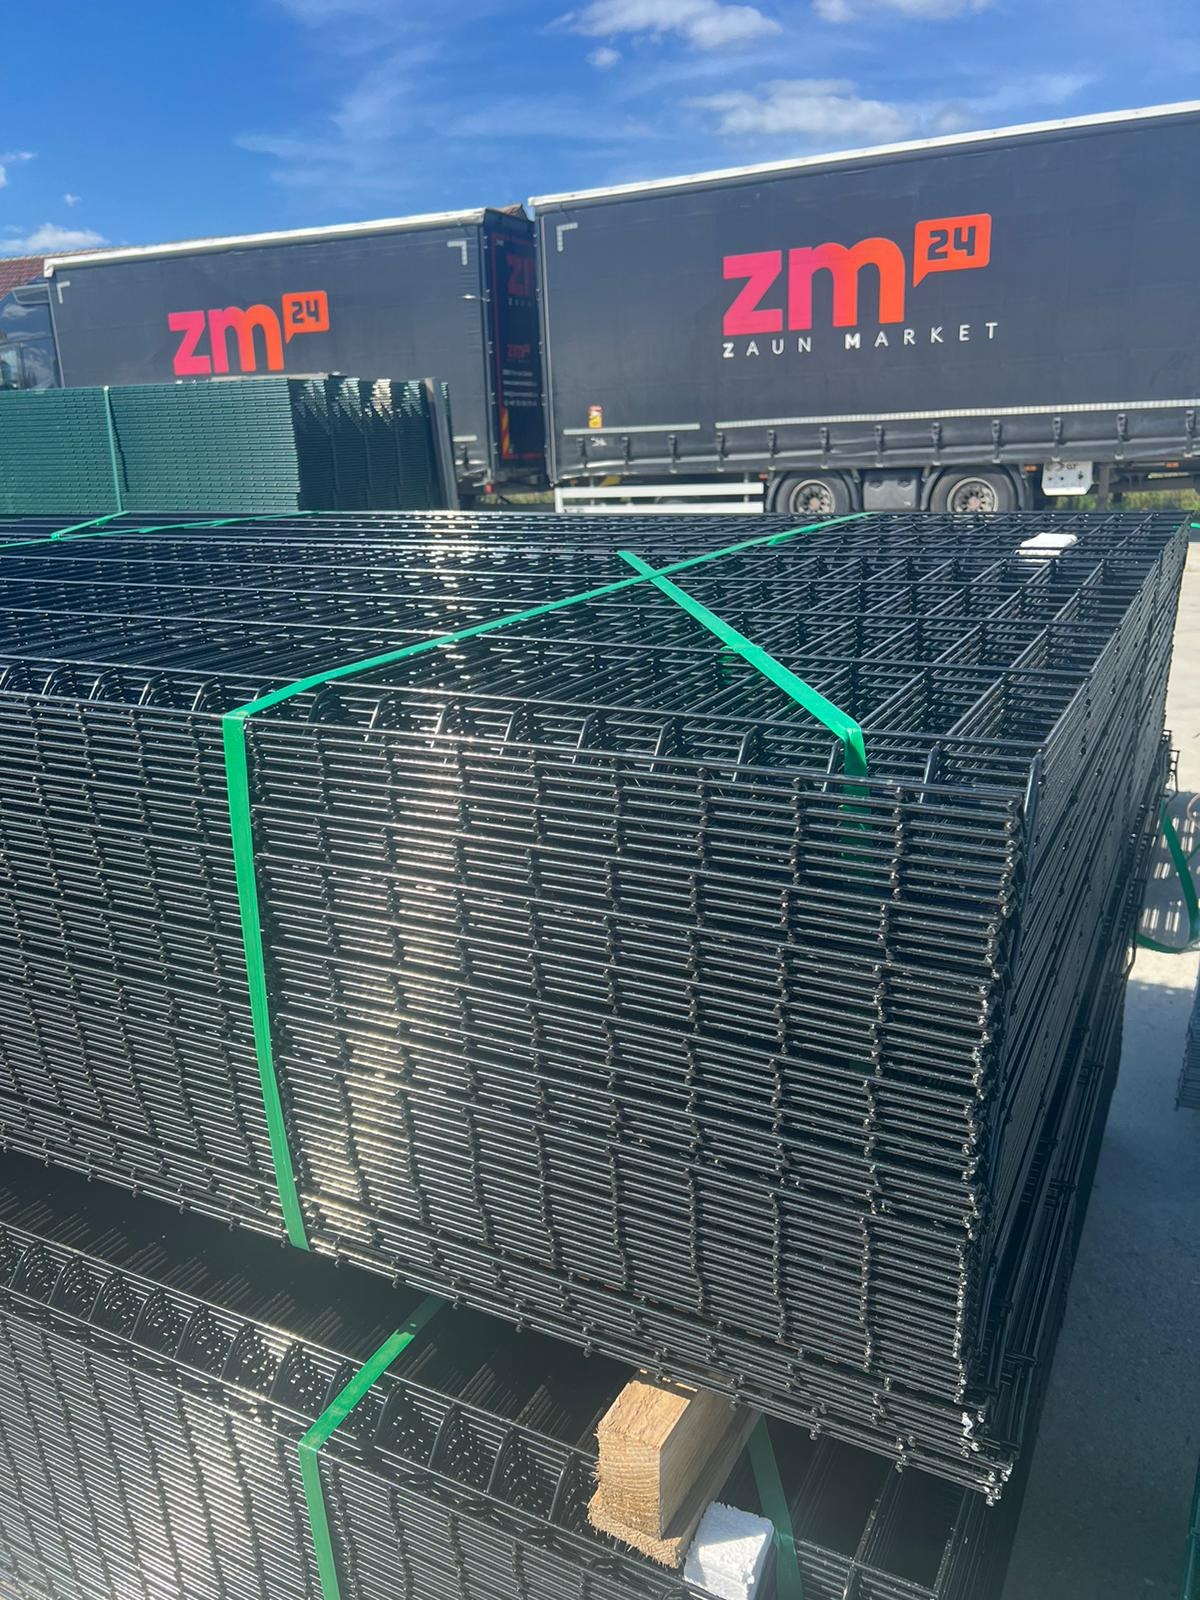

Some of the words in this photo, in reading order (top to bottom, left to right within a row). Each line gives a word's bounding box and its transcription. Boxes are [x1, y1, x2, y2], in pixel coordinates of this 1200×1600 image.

[926, 225, 977, 261] 24
[292, 300, 319, 323] 24
[722, 337, 812, 358] ZAUN
[844, 322, 999, 350] MARKET
